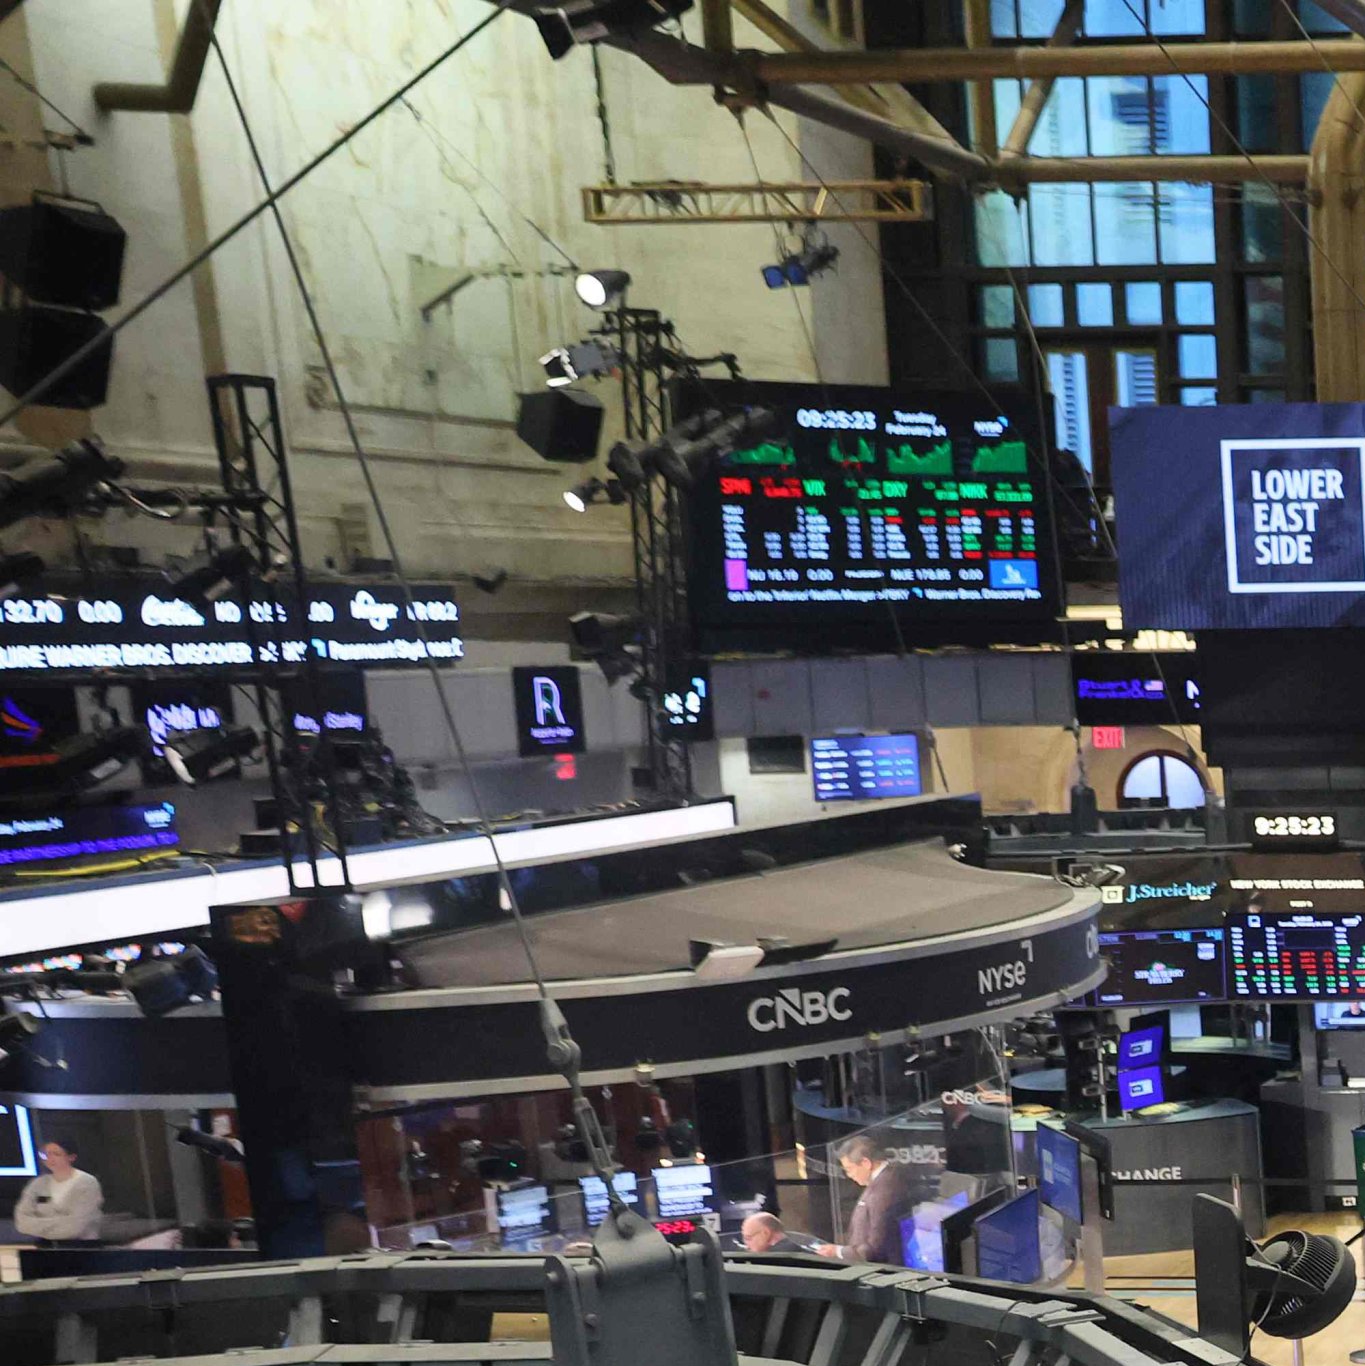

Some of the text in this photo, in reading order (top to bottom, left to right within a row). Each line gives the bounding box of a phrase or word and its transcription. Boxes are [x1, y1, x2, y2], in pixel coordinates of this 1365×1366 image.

[1251, 468, 1345, 500] LOWER
[1253, 502, 1320, 533] EAST
[1255, 535, 1314, 566] SIDE
[1094, 727, 1121, 747] EXIT
[1254, 815, 1335, 836] 9:25:23
[978, 960, 1026, 995] NYSE
[747, 987, 853, 1032] CNBC
